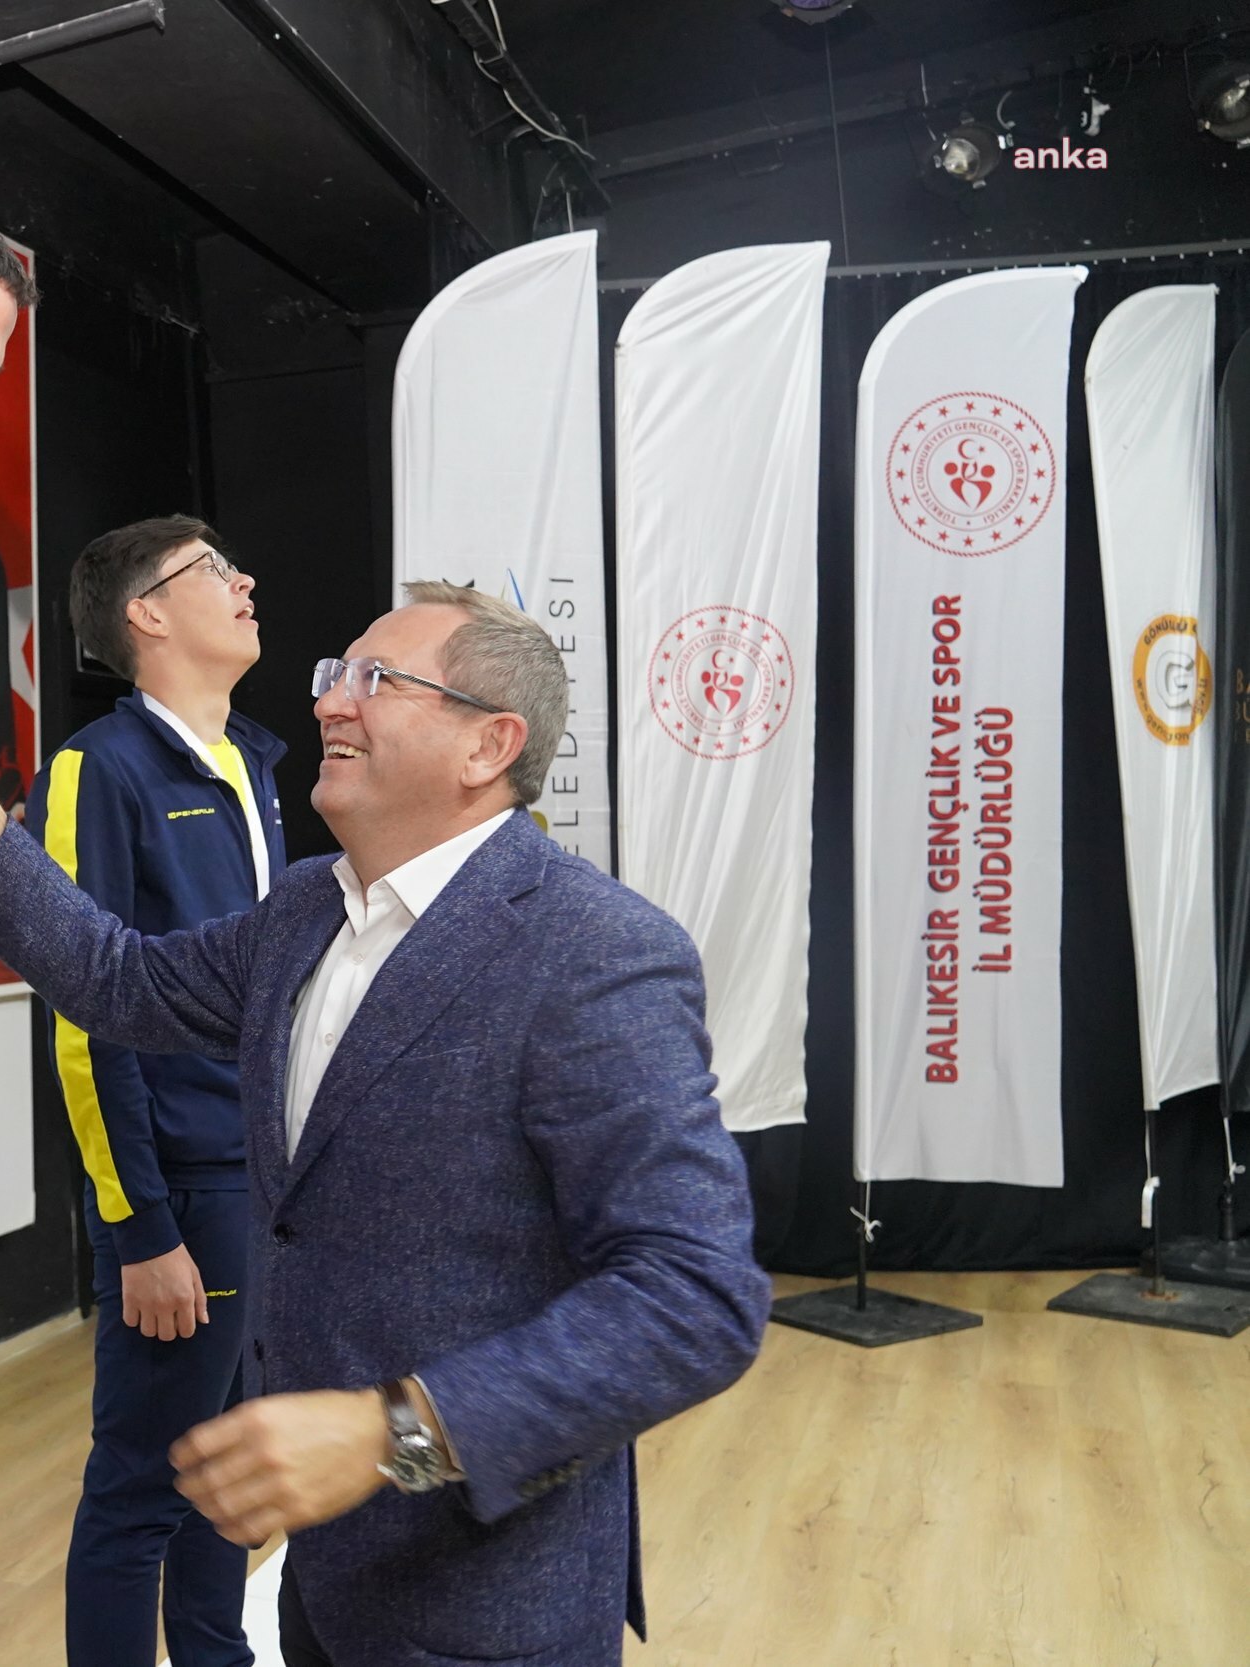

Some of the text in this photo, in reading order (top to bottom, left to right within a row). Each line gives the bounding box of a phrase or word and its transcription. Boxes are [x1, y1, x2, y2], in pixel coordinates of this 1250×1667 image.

[921, 594, 970, 1084] BALIKESİR GENÇLİK VE SPOR
[971, 707, 1014, 973] İL MÜDÜRLÜĞÜ
